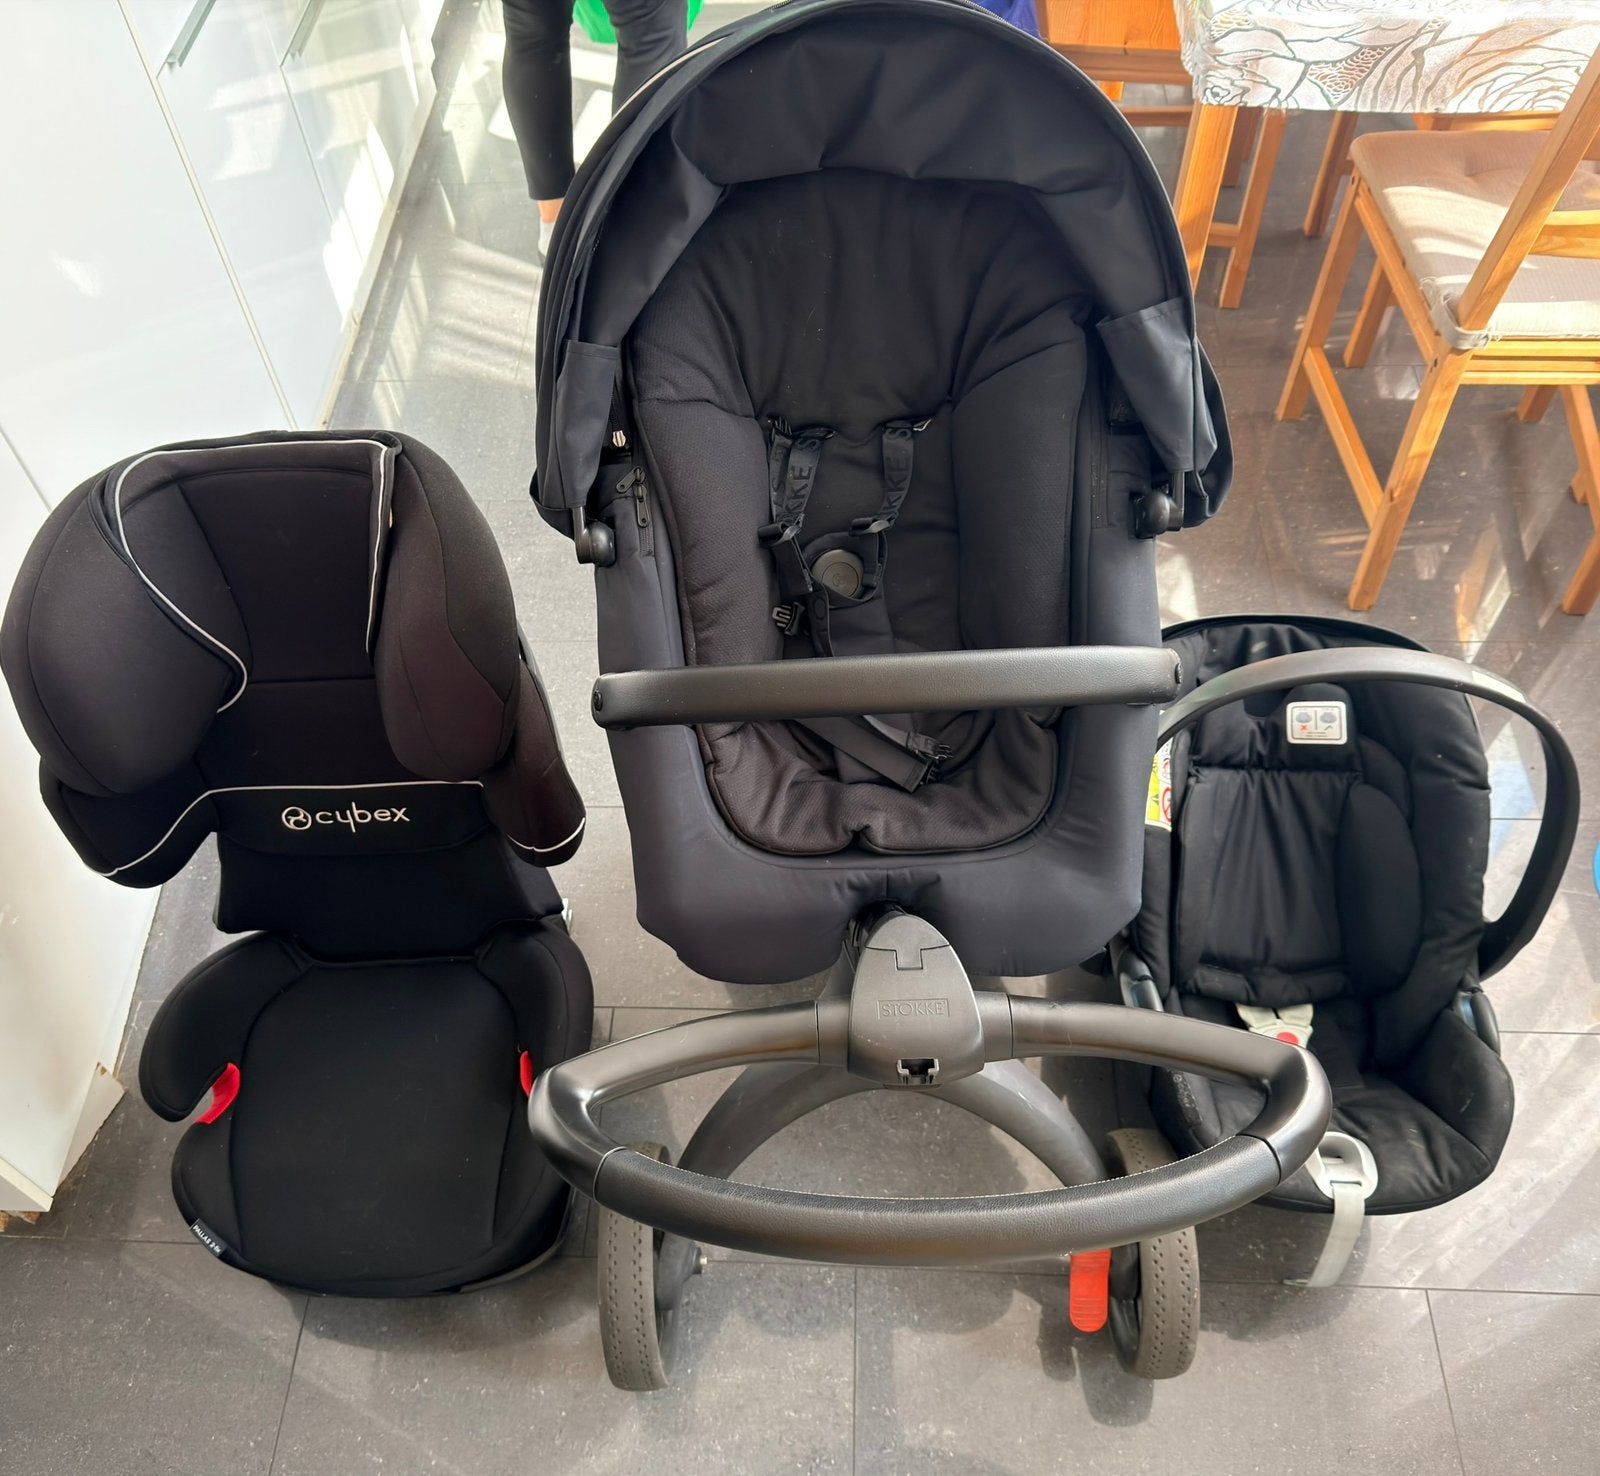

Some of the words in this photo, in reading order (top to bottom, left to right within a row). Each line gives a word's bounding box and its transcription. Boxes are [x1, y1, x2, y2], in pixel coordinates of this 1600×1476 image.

[315, 801, 410, 833] cybex
[881, 1001, 945, 1017] STOKKE
[193, 1224, 212, 1244] PALLAS
